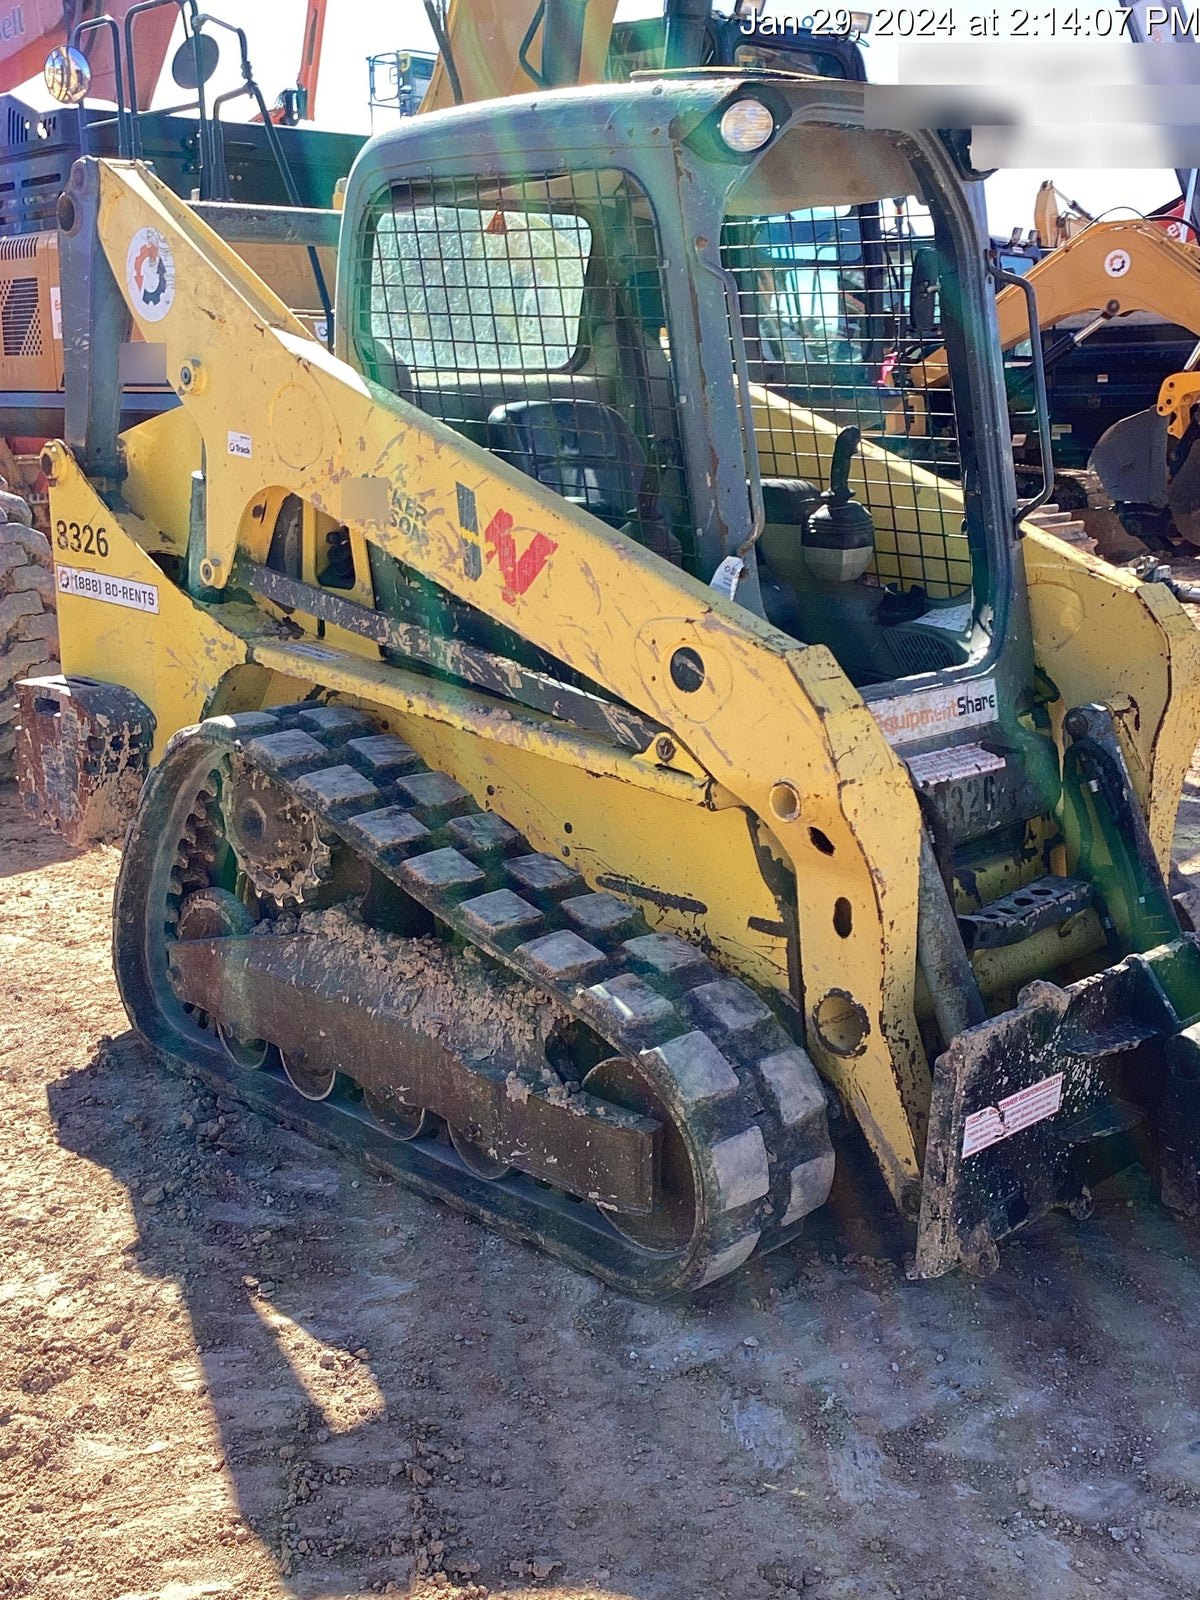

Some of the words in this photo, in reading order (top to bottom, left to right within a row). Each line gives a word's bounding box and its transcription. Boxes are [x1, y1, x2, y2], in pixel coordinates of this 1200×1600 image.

[56, 519, 109, 558] 8326
[75, 574, 102, 595] (888)
[104, 582, 155, 606] 80-RENTS
